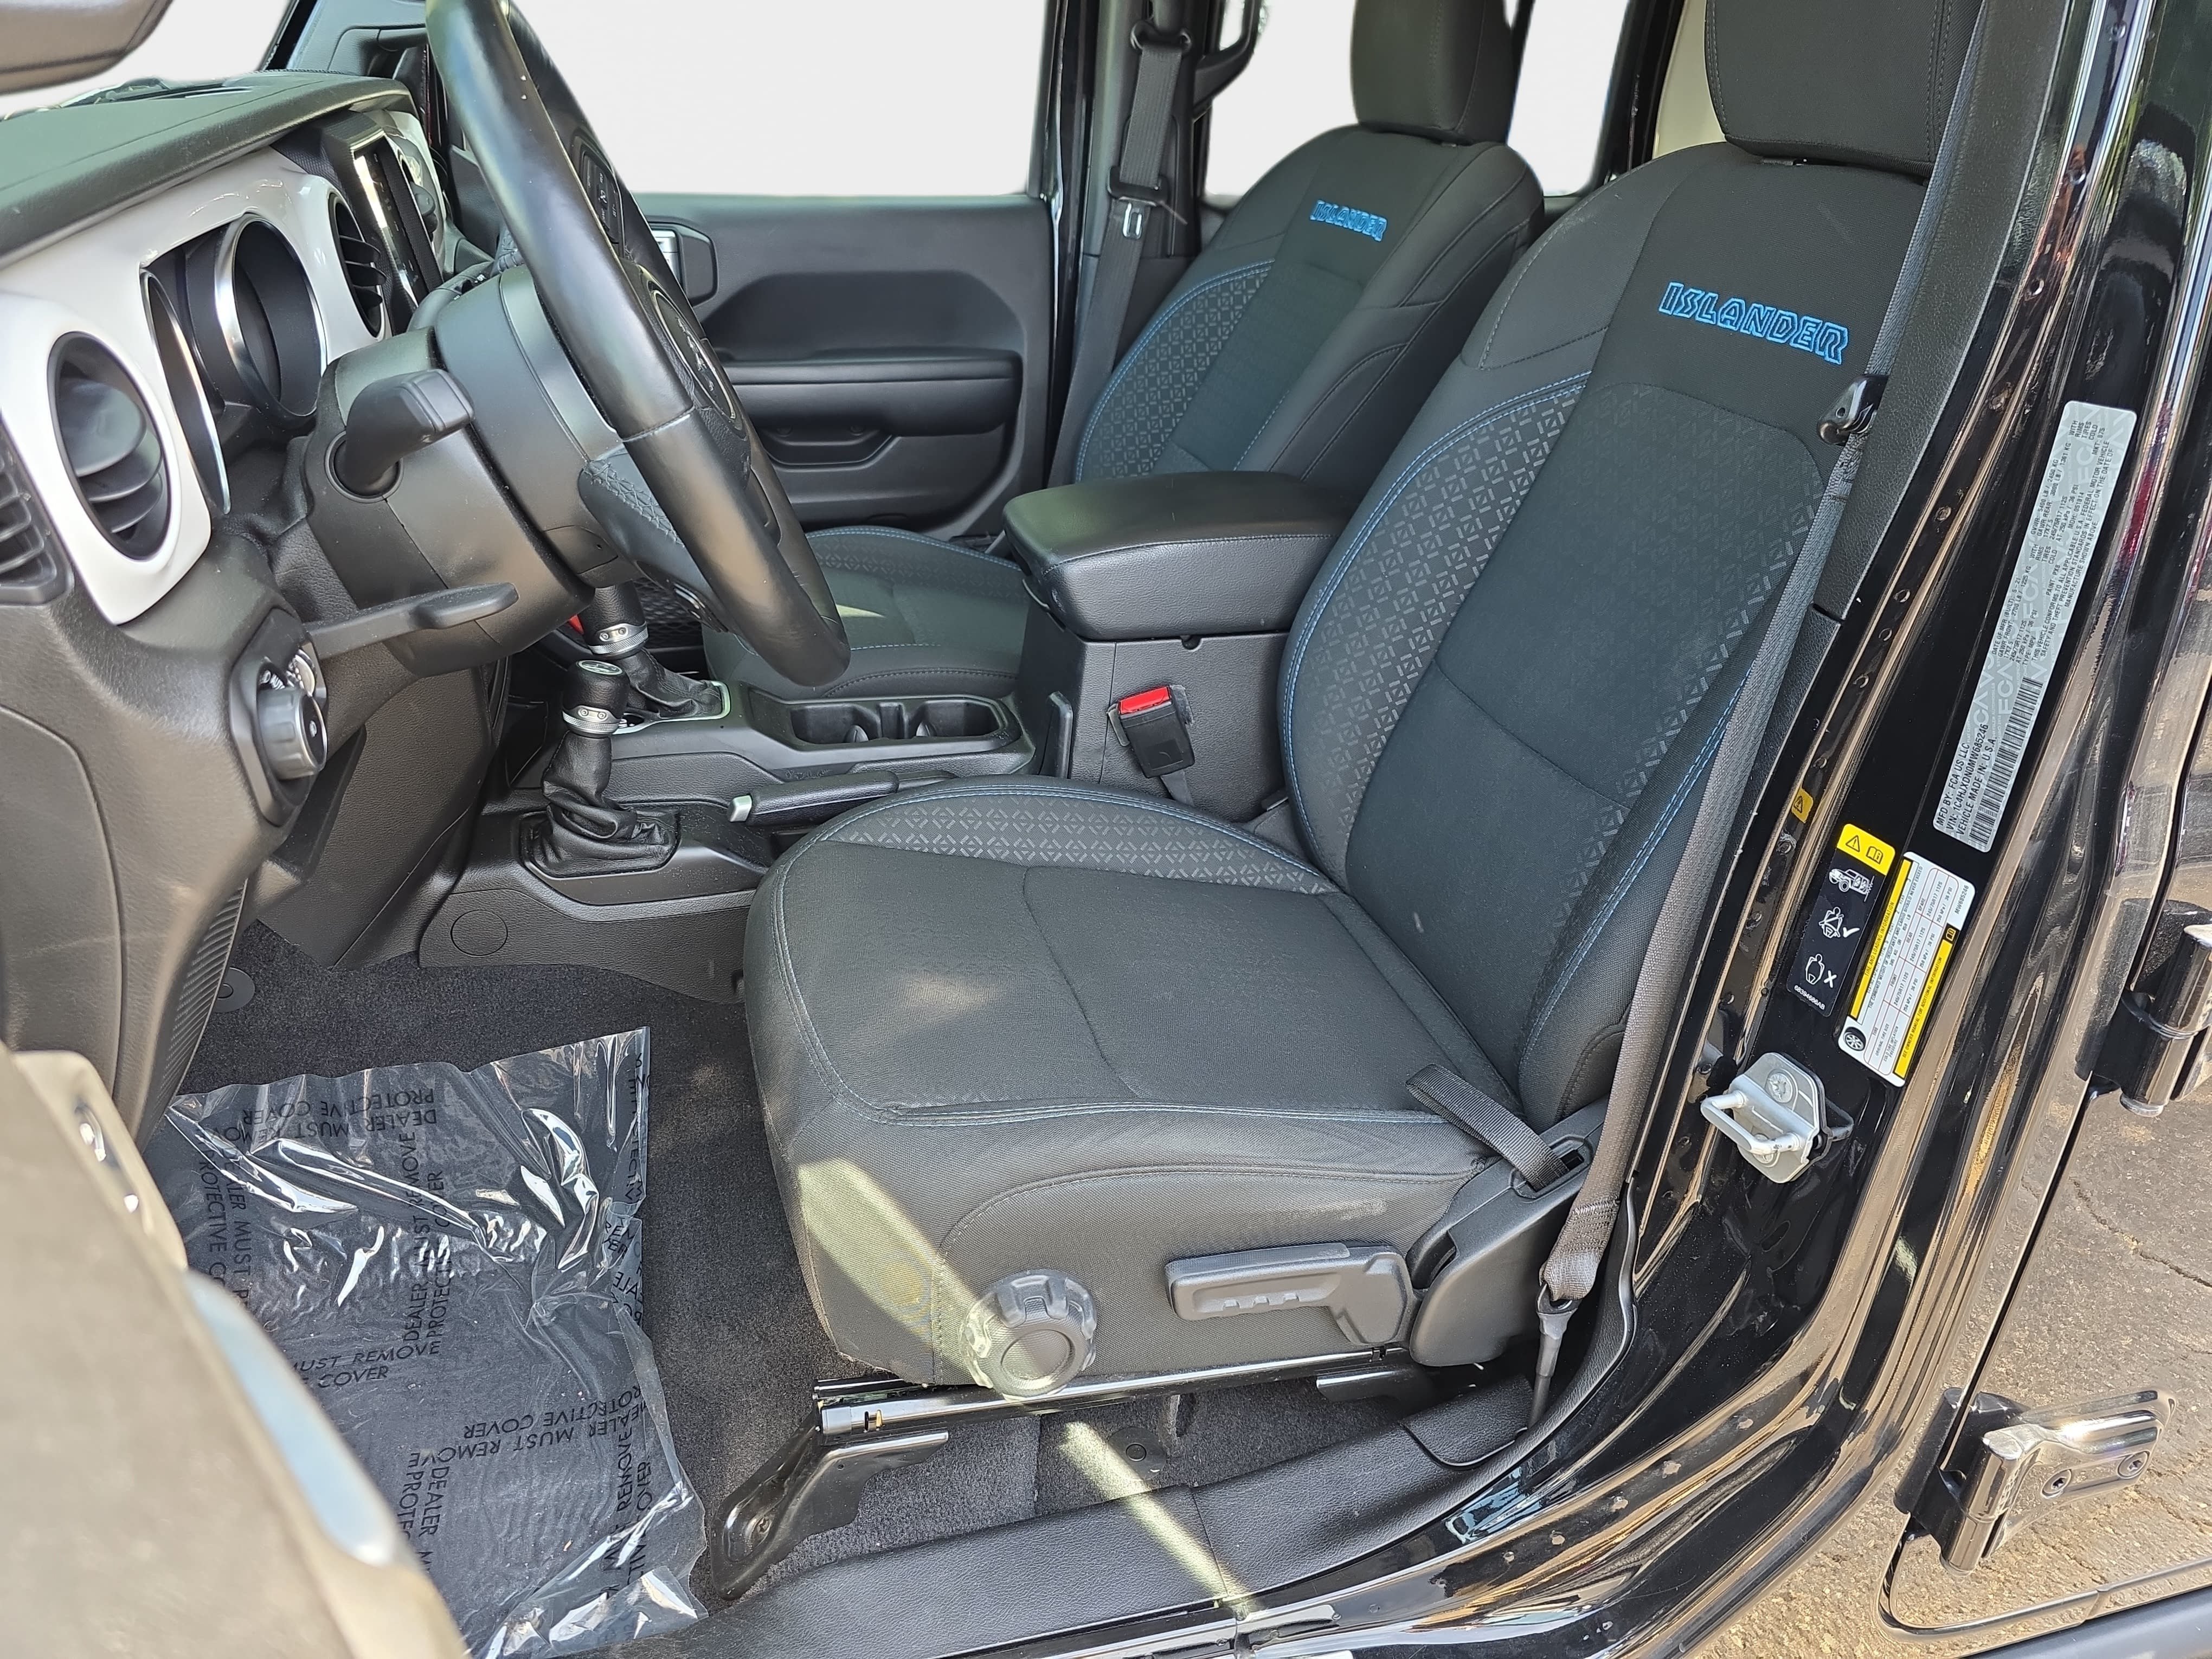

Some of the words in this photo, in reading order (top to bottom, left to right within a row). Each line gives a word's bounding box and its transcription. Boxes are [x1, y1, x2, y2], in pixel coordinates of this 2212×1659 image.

[1310, 200, 1387, 242] ISLANDER
[1658, 282, 1848, 364] ISLANDER
[2075, 421, 2085, 438] RIMS
[2081, 421, 2092, 439] TIRES
[2088, 424, 2098, 440] COLD
[2096, 440, 2110, 465] VEHICLE
[2107, 448, 2115, 456] OF
[2101, 458, 2112, 474] DATE
[2036, 518, 2046, 536] GAWR
[2068, 420, 2078, 436] WITH
[2089, 467, 2101, 488] MOTOR
[2097, 475, 2106, 487] THE
[2080, 489, 2093, 516] FEDERAL
[2093, 489, 2101, 498] ON
[2086, 499, 2098, 521] EFFECT
[2035, 546, 2044, 561] RIMS
[2041, 545, 2051, 562] TIRES
[2048, 549, 2057, 564] COLD
[2061, 536, 2078, 571] APPLICABLE
[2070, 530, 2087, 565] STANDARDS
[2057, 573, 2066, 583] ALL
[2059, 566, 2075, 602] PREVENTION
[2064, 564, 2083, 607] MANUFACTURE
[2079, 542, 2091, 564] SHOWN
[1998, 640, 2007, 657] GAWR
[2029, 543, 2038, 558] WITH
[2044, 593, 2059, 624] CONFORMS
[2052, 603, 2063, 621] THEFT
[1996, 631, 2003, 639] OF
[1999, 619, 2007, 631] MFR
[2036, 625, 2048, 647] VEHICLE
[2048, 622, 2056, 634] AND
[1991, 640, 2000, 655] DATE
[2028, 635, 2036, 648] MPV
[2040, 635, 2052, 657] SAFETY
[2031, 648, 2040, 662] THIS
[1958, 742, 1970, 758] LLC
[1982, 734, 1997, 761] U.S.A.
[1954, 758, 1964, 772] US
[1977, 762, 1988, 775] IN:
[1946, 813, 1958, 831] VIN:
[1952, 722, 1989, 813] 1C4HJXDN0MW685246
[1948, 772, 1959, 789] FCA
[1943, 790, 1953, 806] BY:
[1968, 776, 1983, 801] MADE
[1936, 806, 1948, 826] MFD
[1956, 801, 1973, 836] VEHICLE
[1872, 933, 1882, 955] LOADING
[1879, 901, 1894, 934] INFORMATION
[320, 1089, 434, 1117] PROTECTVE
[294, 1121, 349, 1139] MUST
[364, 1109, 436, 1131] DEALER
[234, 1221, 252, 1275] MUST
[404, 1282, 429, 1341] DEALER
[352, 1341, 441, 1362] REMOVE
[318, 1366, 389, 1388] COVER
[543, 1386, 641, 1427] ROTECTIVE
[464, 1414, 534, 1439] COVER
[513, 1427, 574, 1451] MUST
[408, 1439, 501, 1468] REMOVE
[419, 1467, 450, 1538] DEALER
